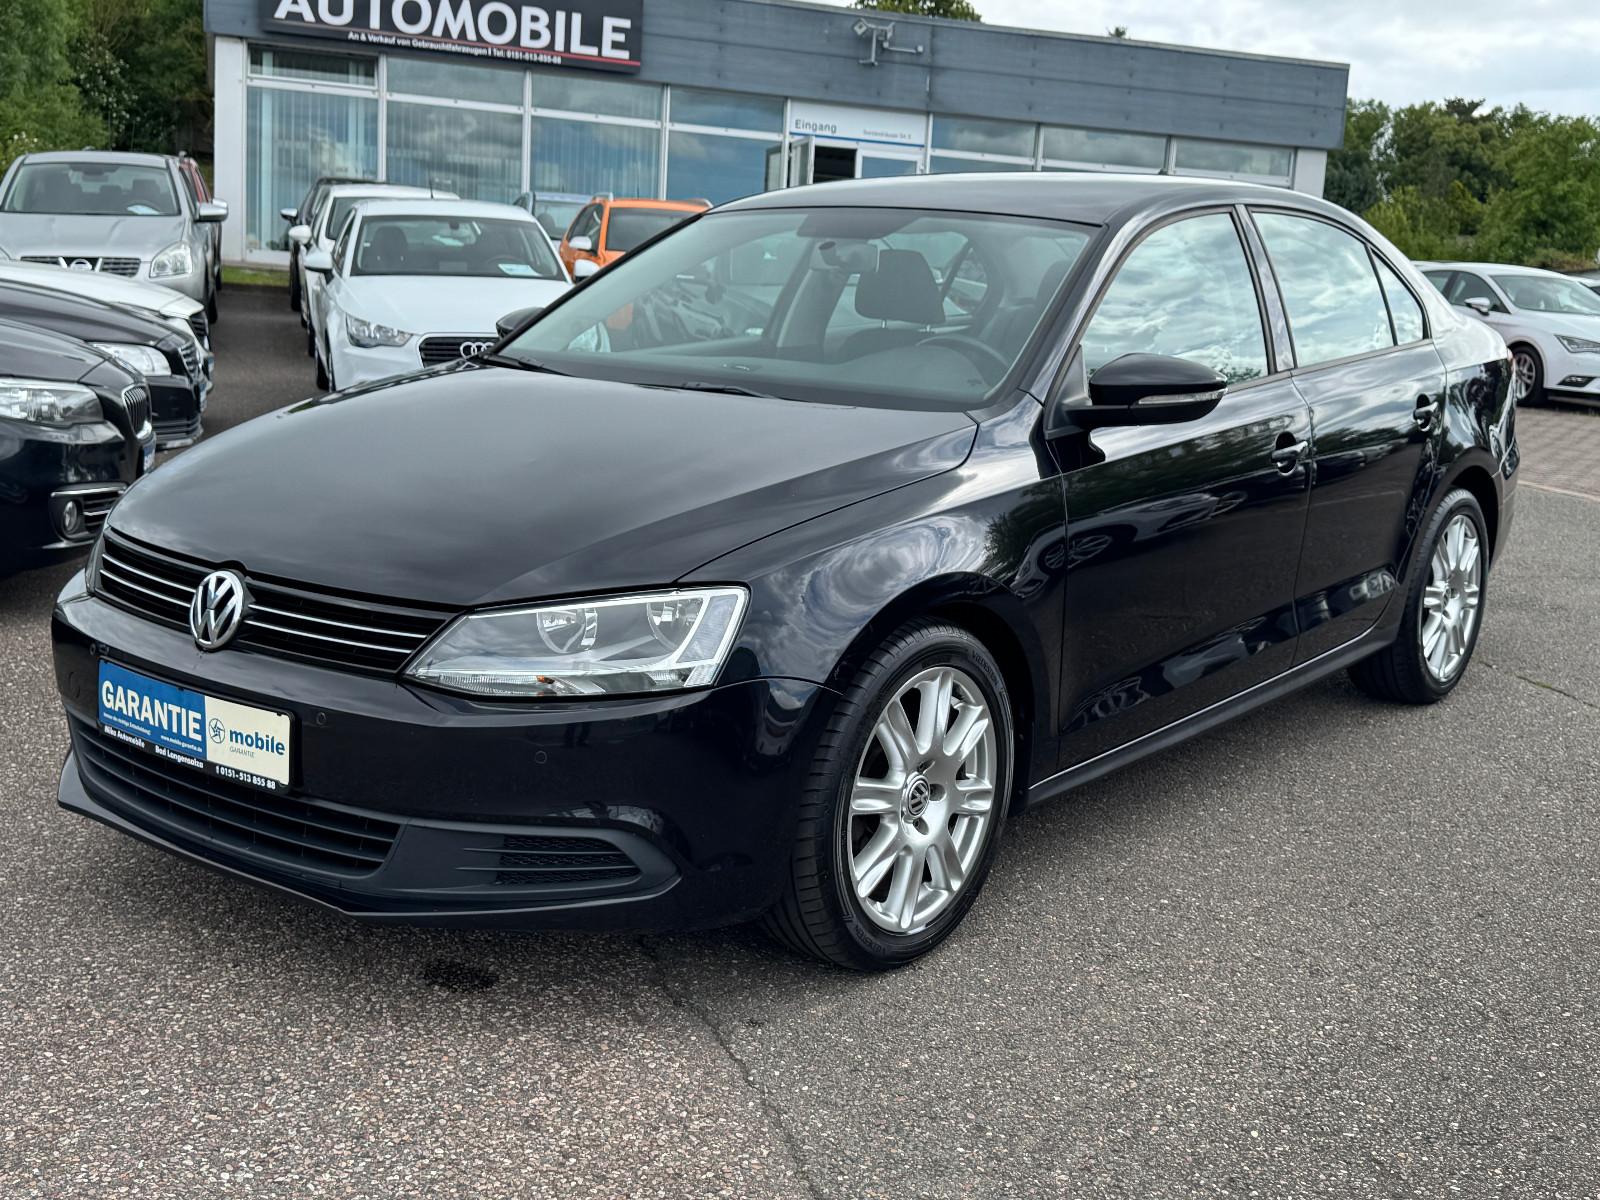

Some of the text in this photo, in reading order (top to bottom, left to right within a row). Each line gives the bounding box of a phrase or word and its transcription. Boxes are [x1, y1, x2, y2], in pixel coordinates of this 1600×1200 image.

[274, 0, 631, 60] AUTOMOBILE
[367, 33, 395, 45] Verkauf
[396, 38, 411, 46] von
[795, 119, 837, 134] Eingang
[101, 680, 203, 742] GARANTIE
[229, 729, 285, 755] mobile
[229, 746, 255, 758] GARANTIE
[155, 745, 167, 756] Bad
[252, 775, 265, 787] 855
[266, 779, 276, 790] 88
